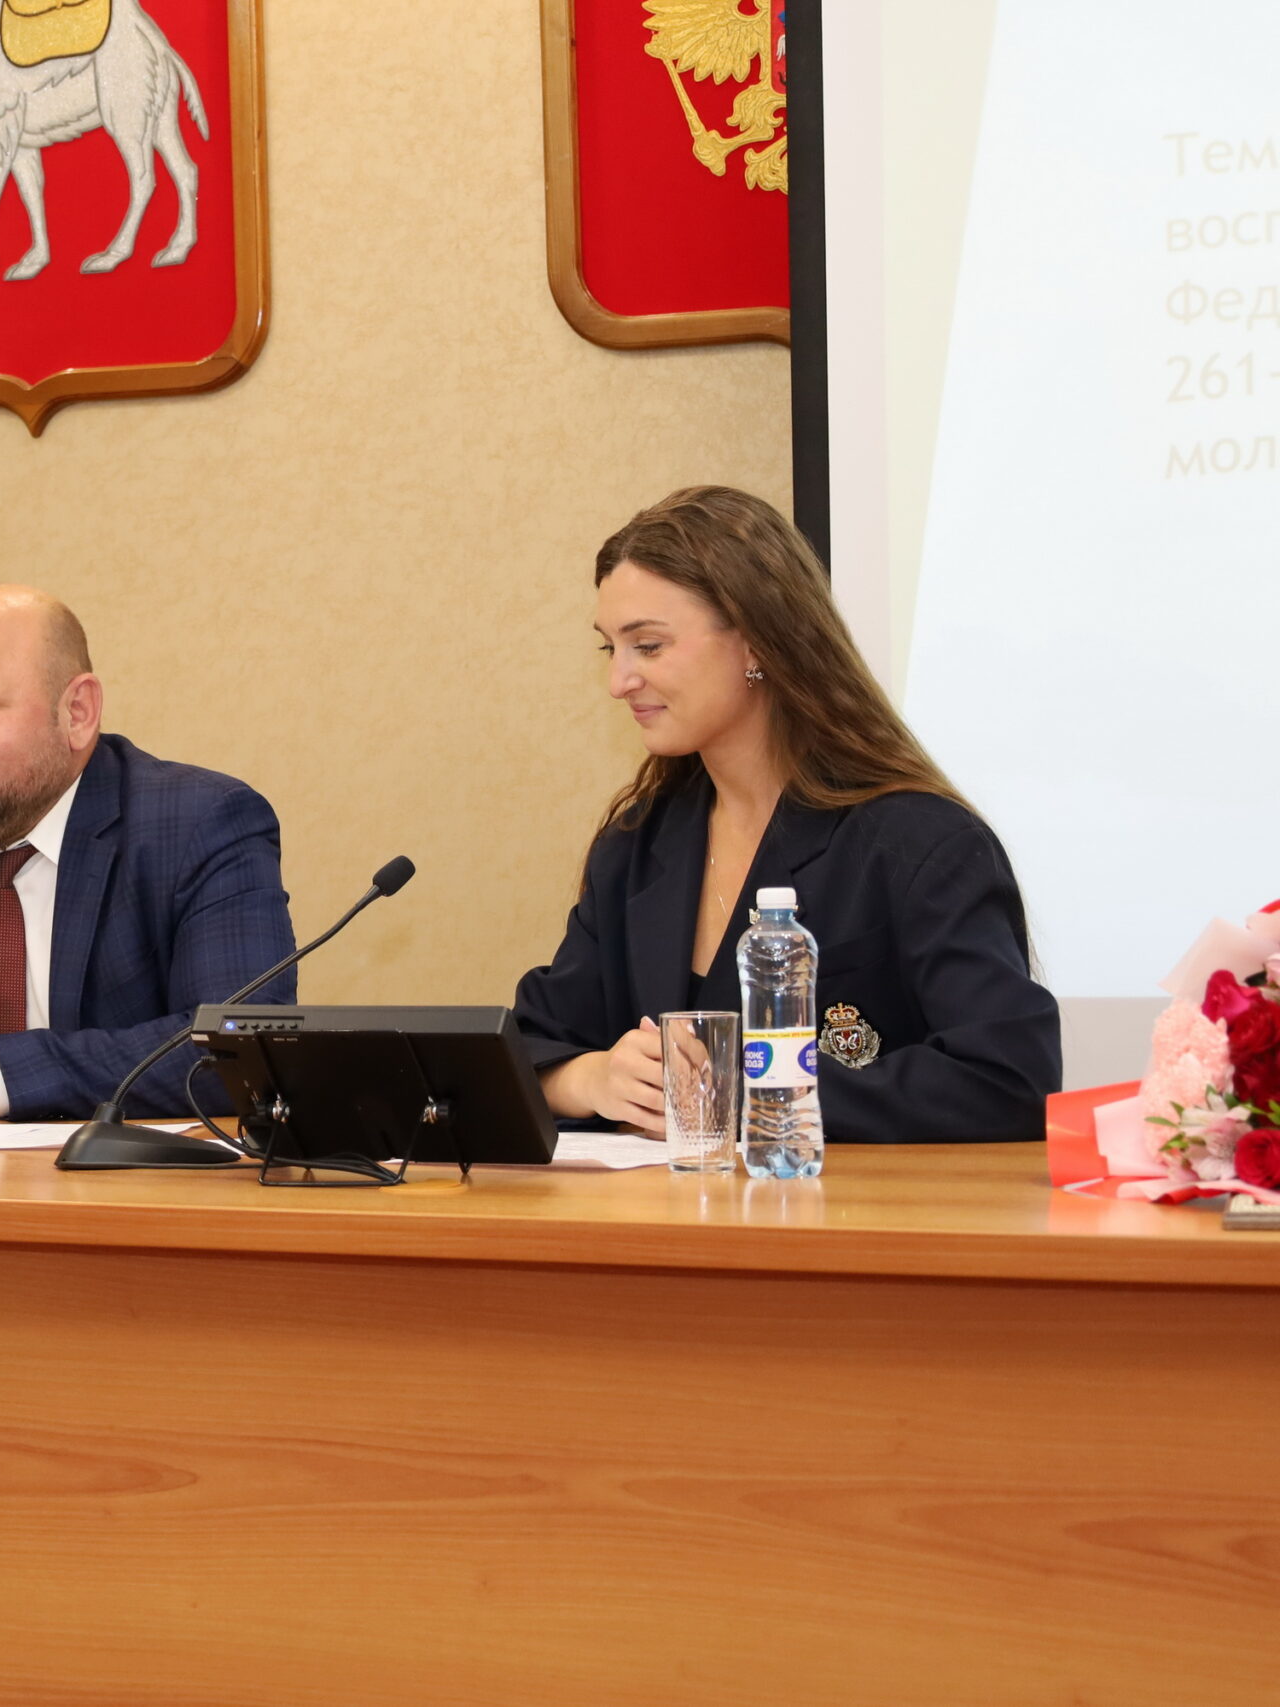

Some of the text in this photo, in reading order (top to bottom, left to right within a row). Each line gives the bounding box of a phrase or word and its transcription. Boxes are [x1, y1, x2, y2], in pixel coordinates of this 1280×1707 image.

[1161, 131, 1280, 178] Тем
[1166, 279, 1280, 332] Фед
[1164, 435, 1280, 480] мол
